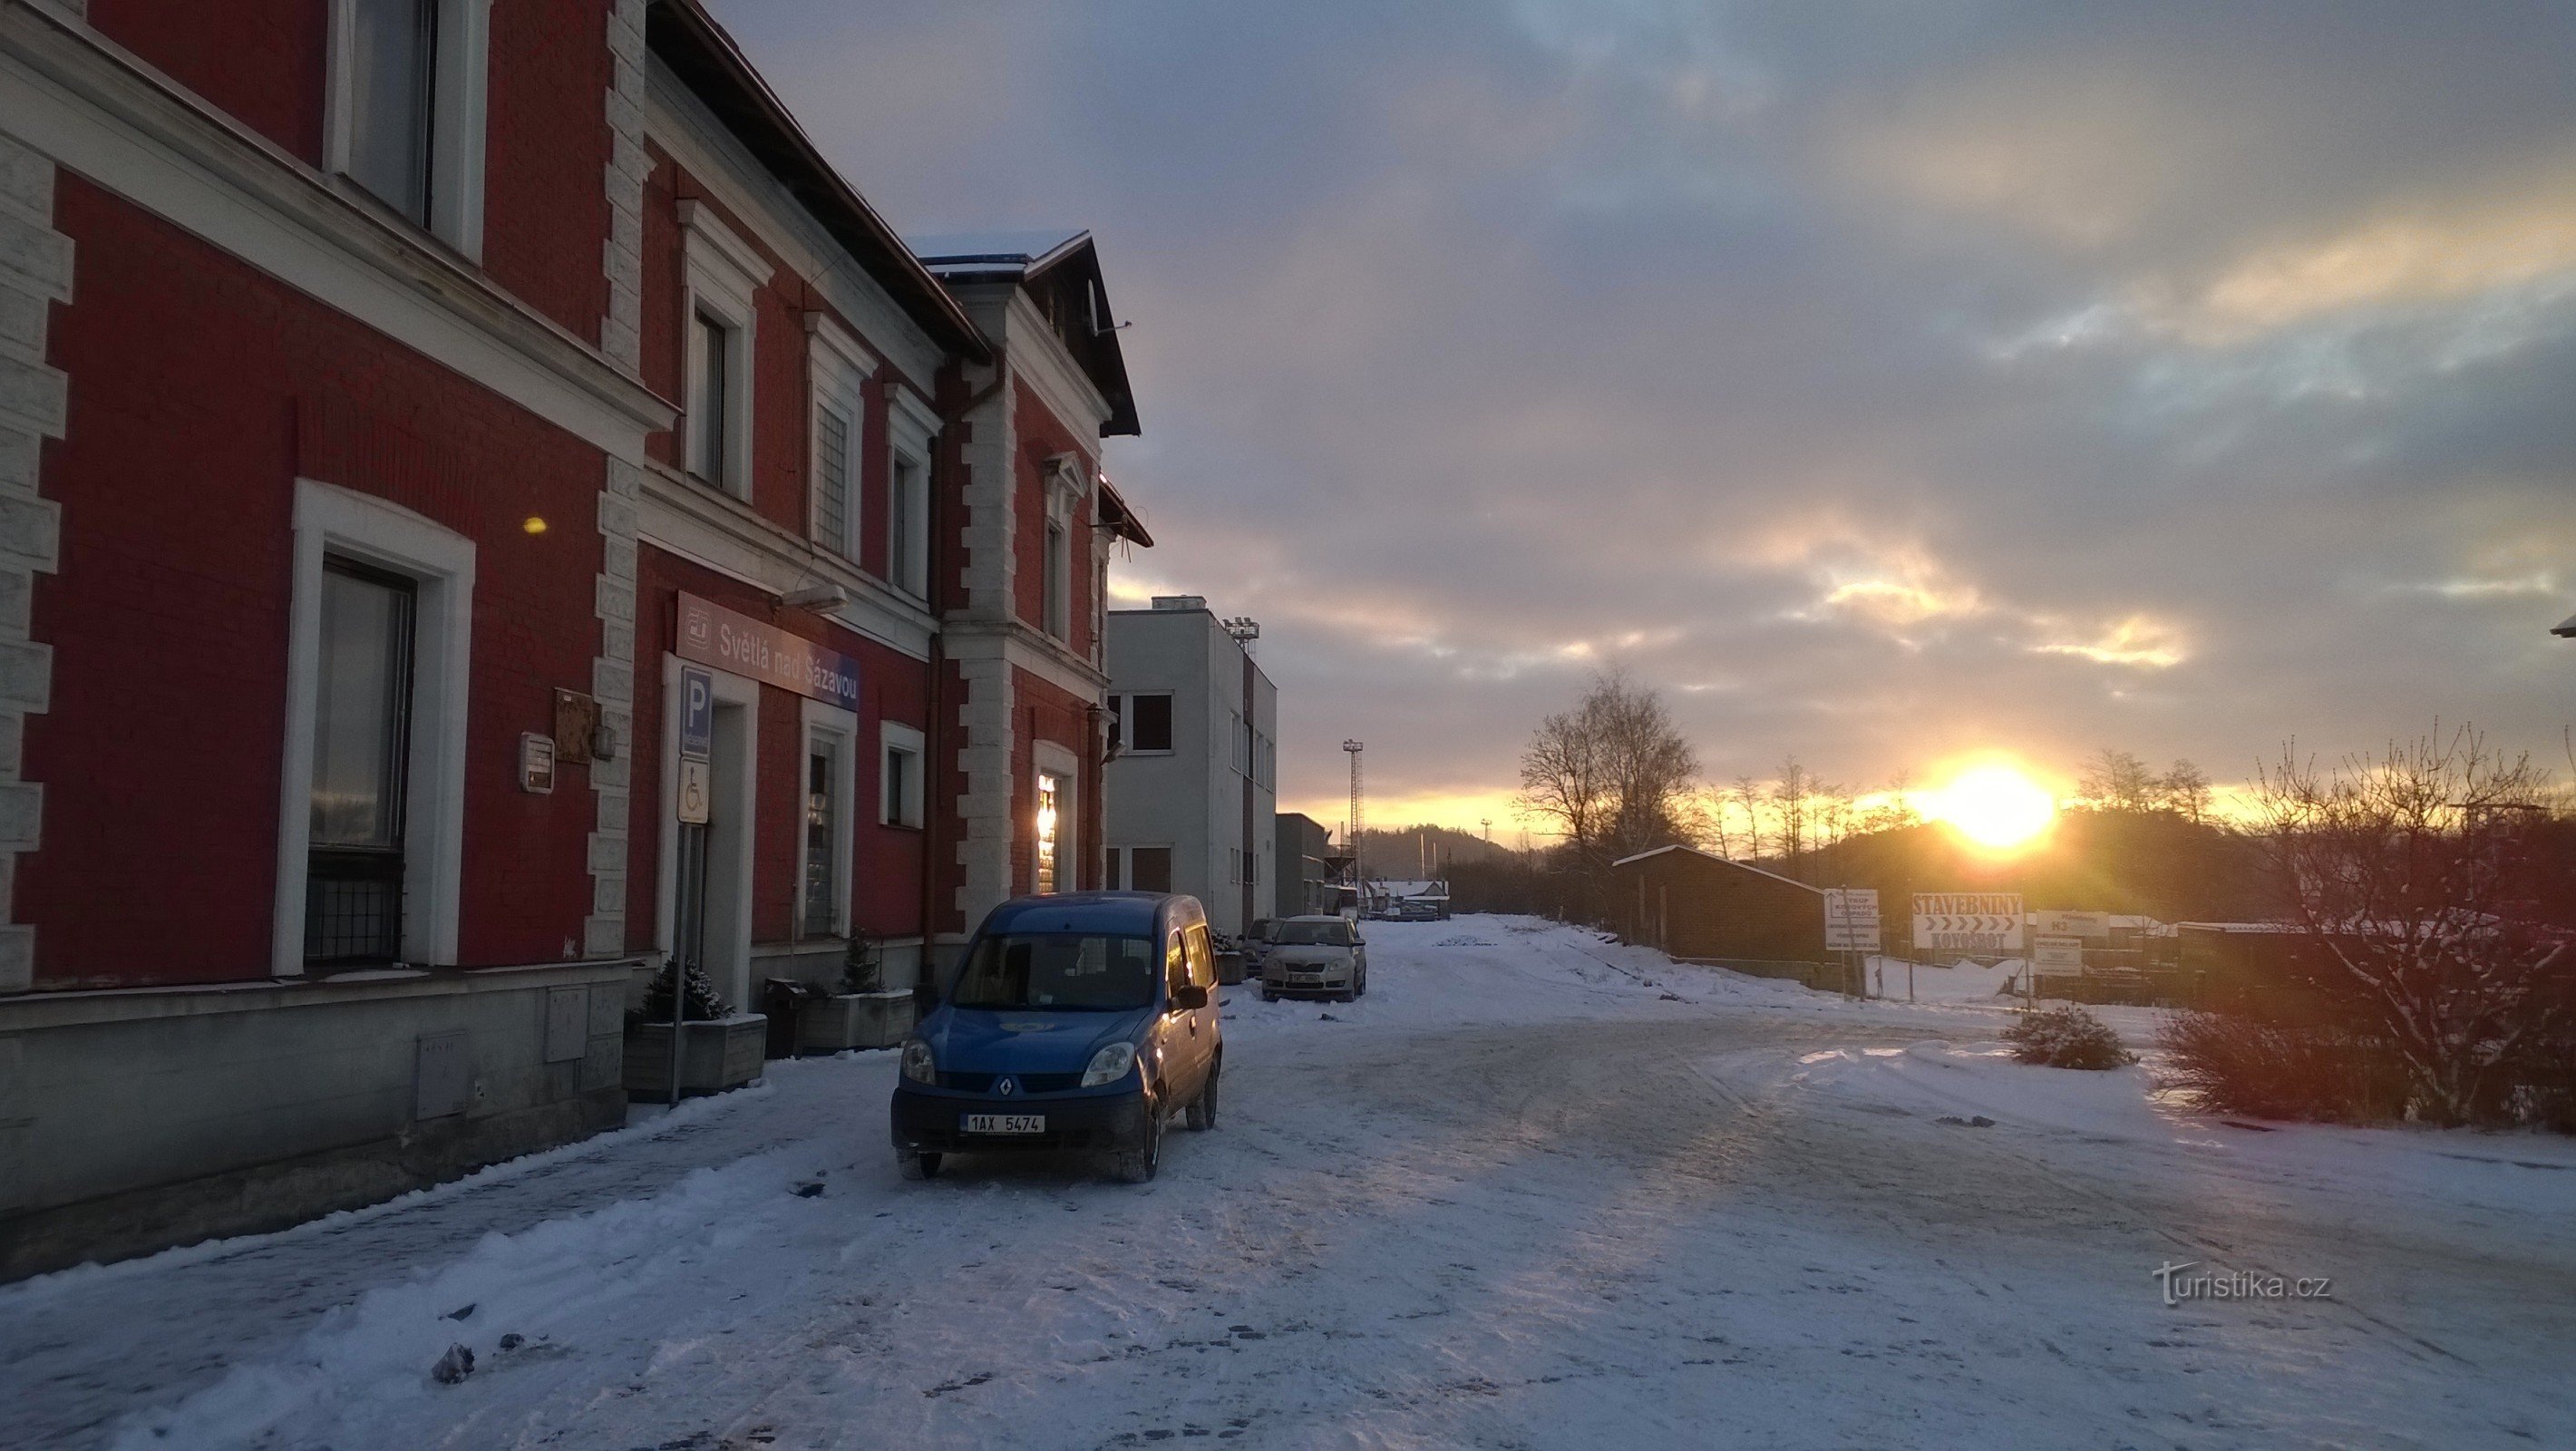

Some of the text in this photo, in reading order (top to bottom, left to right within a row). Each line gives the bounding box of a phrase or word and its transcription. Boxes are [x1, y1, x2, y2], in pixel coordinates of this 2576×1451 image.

[720, 623, 857, 700] Světlá nad Sázavou
[689, 679, 706, 727] P
[1913, 894, 2021, 915] STAVEBNINY
[1931, 930, 2007, 949] KOVOŠROT
[972, 1116, 1039, 1132] 1AX 5474
